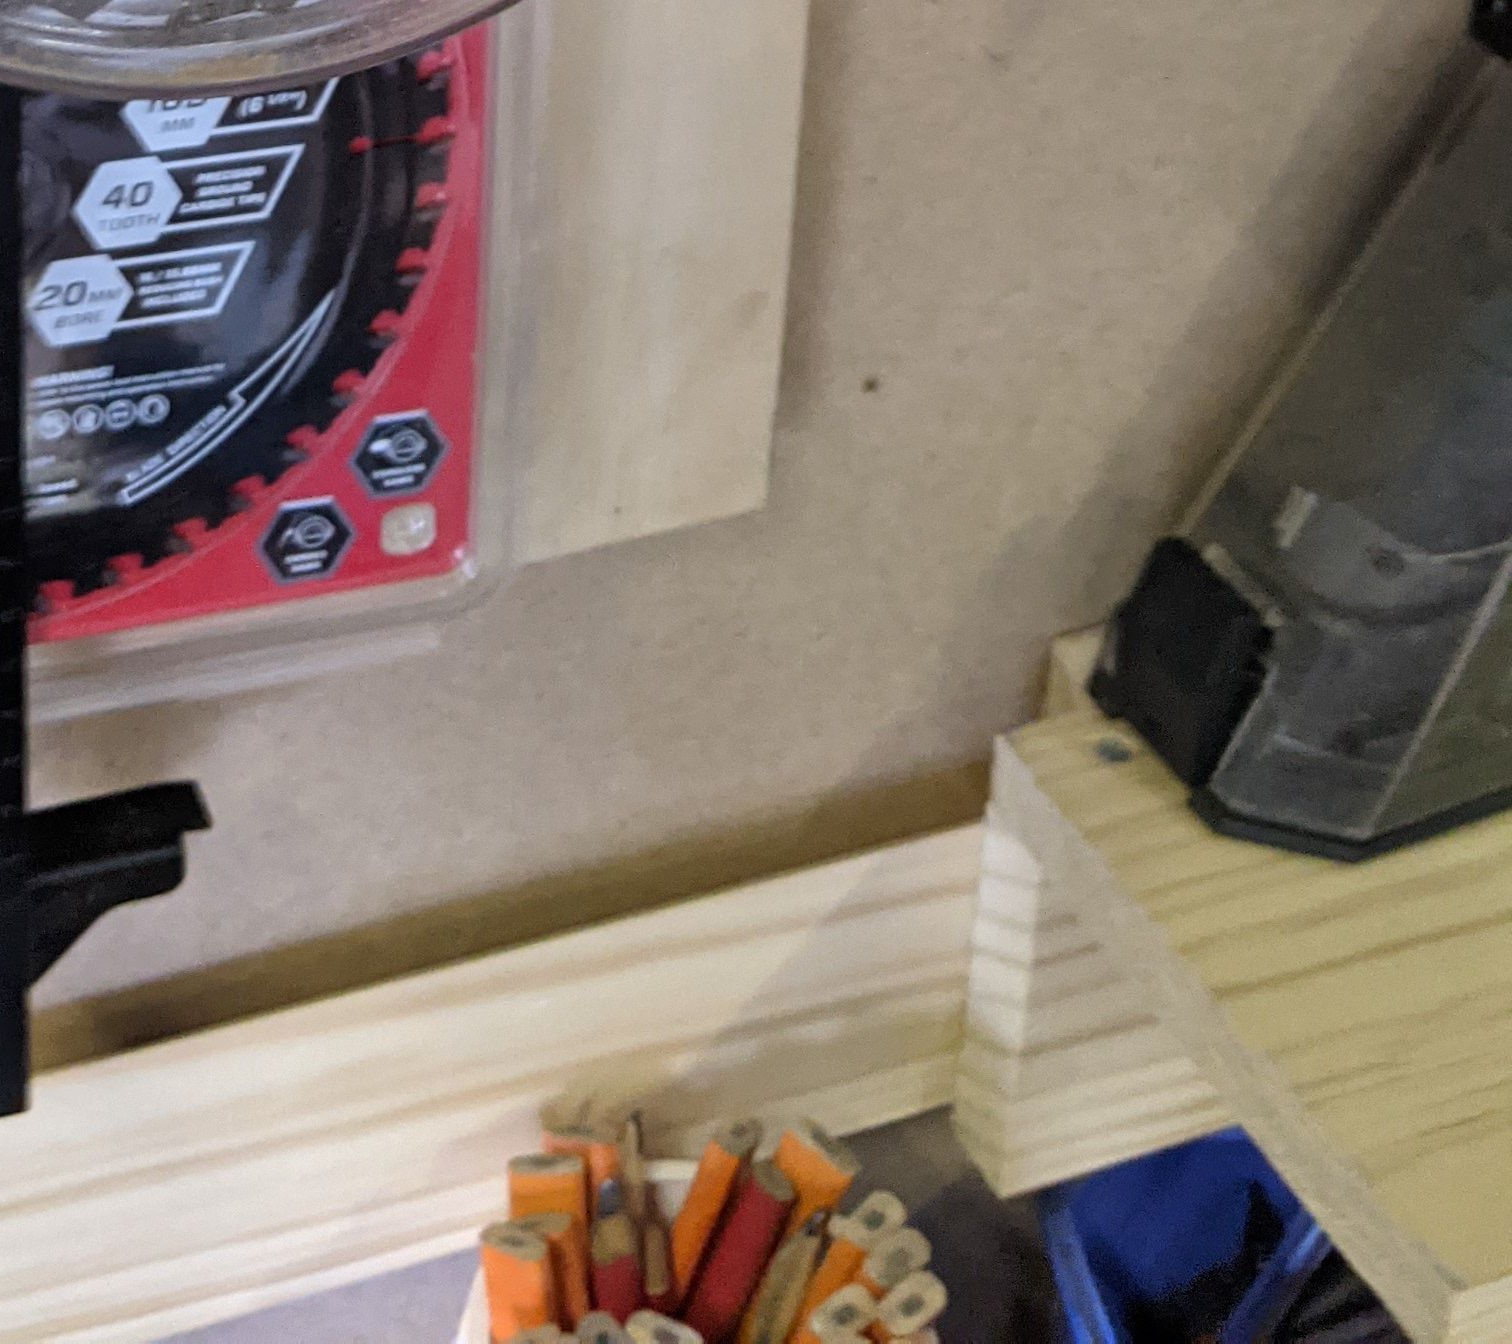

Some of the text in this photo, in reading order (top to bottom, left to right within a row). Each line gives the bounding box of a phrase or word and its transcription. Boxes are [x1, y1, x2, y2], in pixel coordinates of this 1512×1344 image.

[101, 180, 154, 209] 40
[97, 212, 161, 231] TOOTH
[33, 279, 87, 311] 20
